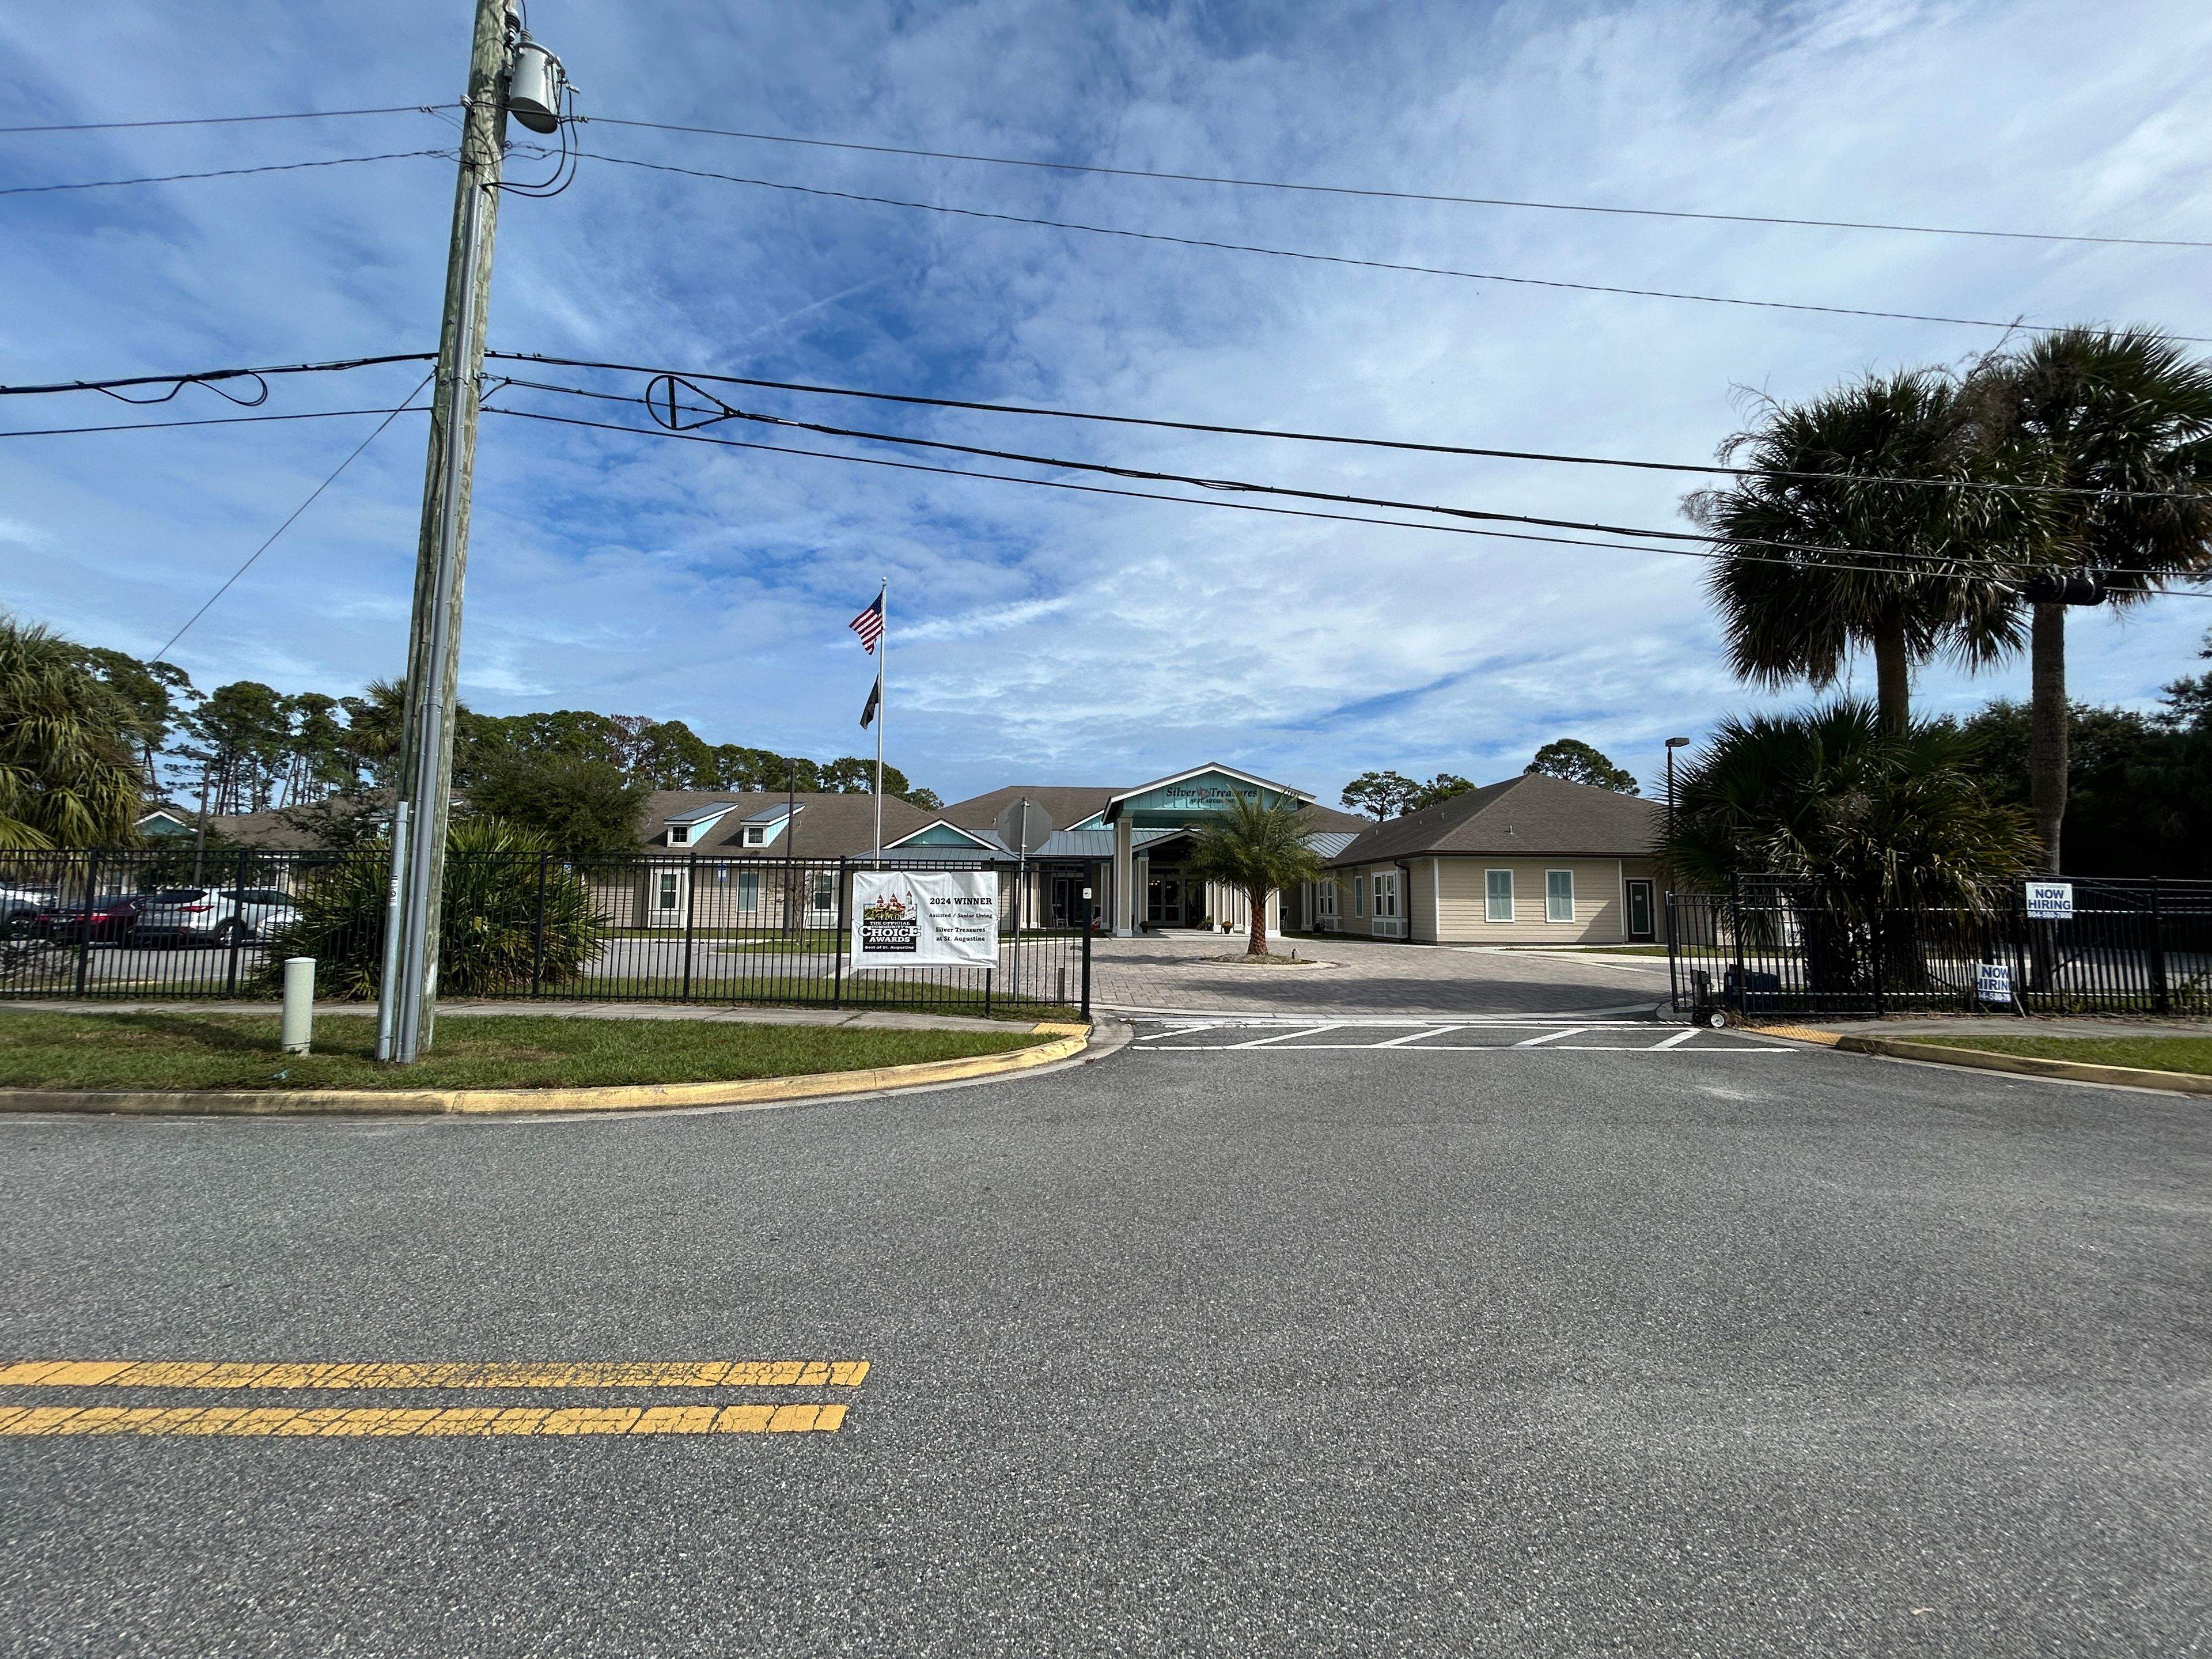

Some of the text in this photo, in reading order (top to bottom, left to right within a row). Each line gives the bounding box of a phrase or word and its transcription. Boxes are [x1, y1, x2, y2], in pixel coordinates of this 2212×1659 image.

[1166, 787, 1196, 797] Silver
[2035, 889, 2064, 899] NOW
[2028, 899, 2071, 910] HIRING
[858, 925, 921, 937] CHOICE
[1982, 967, 2009, 978] NOW
[1978, 979, 2009, 991] HIRIN
